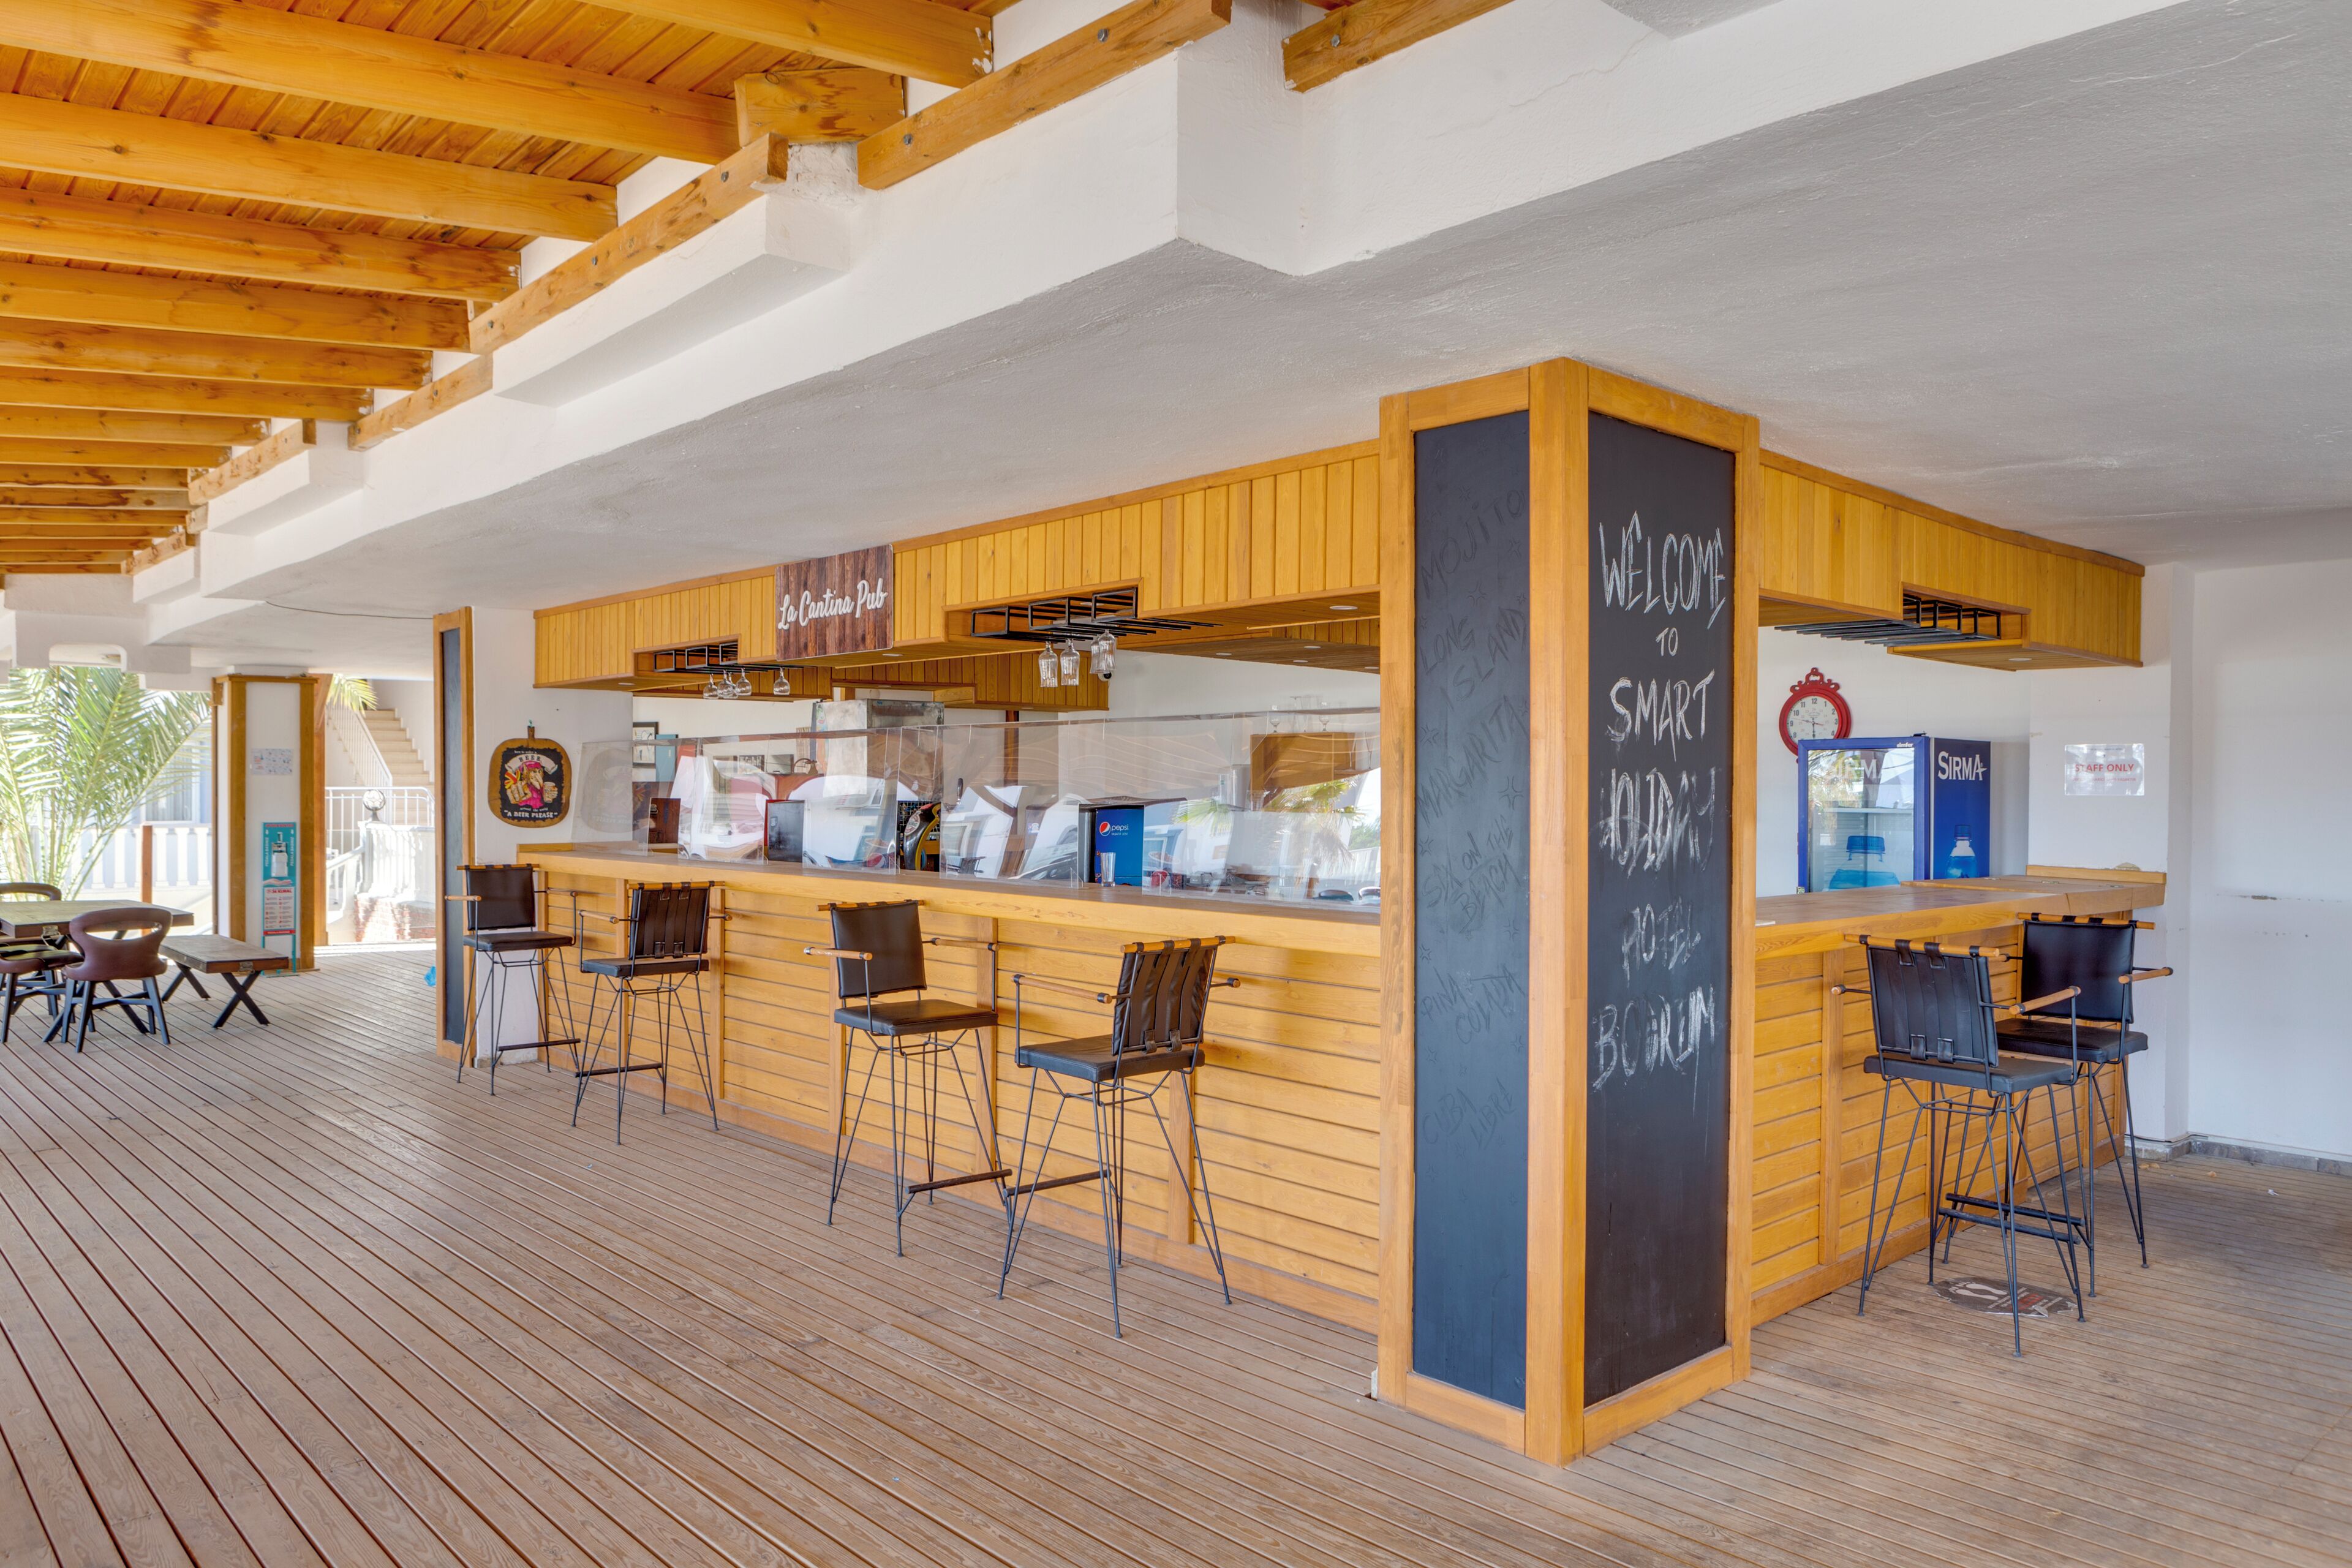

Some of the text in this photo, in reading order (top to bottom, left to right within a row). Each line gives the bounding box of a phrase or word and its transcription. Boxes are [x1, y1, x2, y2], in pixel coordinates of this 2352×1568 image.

[1599, 511, 1726, 630] WELCOME
[778, 578, 888, 630] La Cantina Pub
[1656, 627, 1678, 656] TO
[1607, 668, 1715, 761] SMART
[1938, 751, 1988, 781] SIRMA
